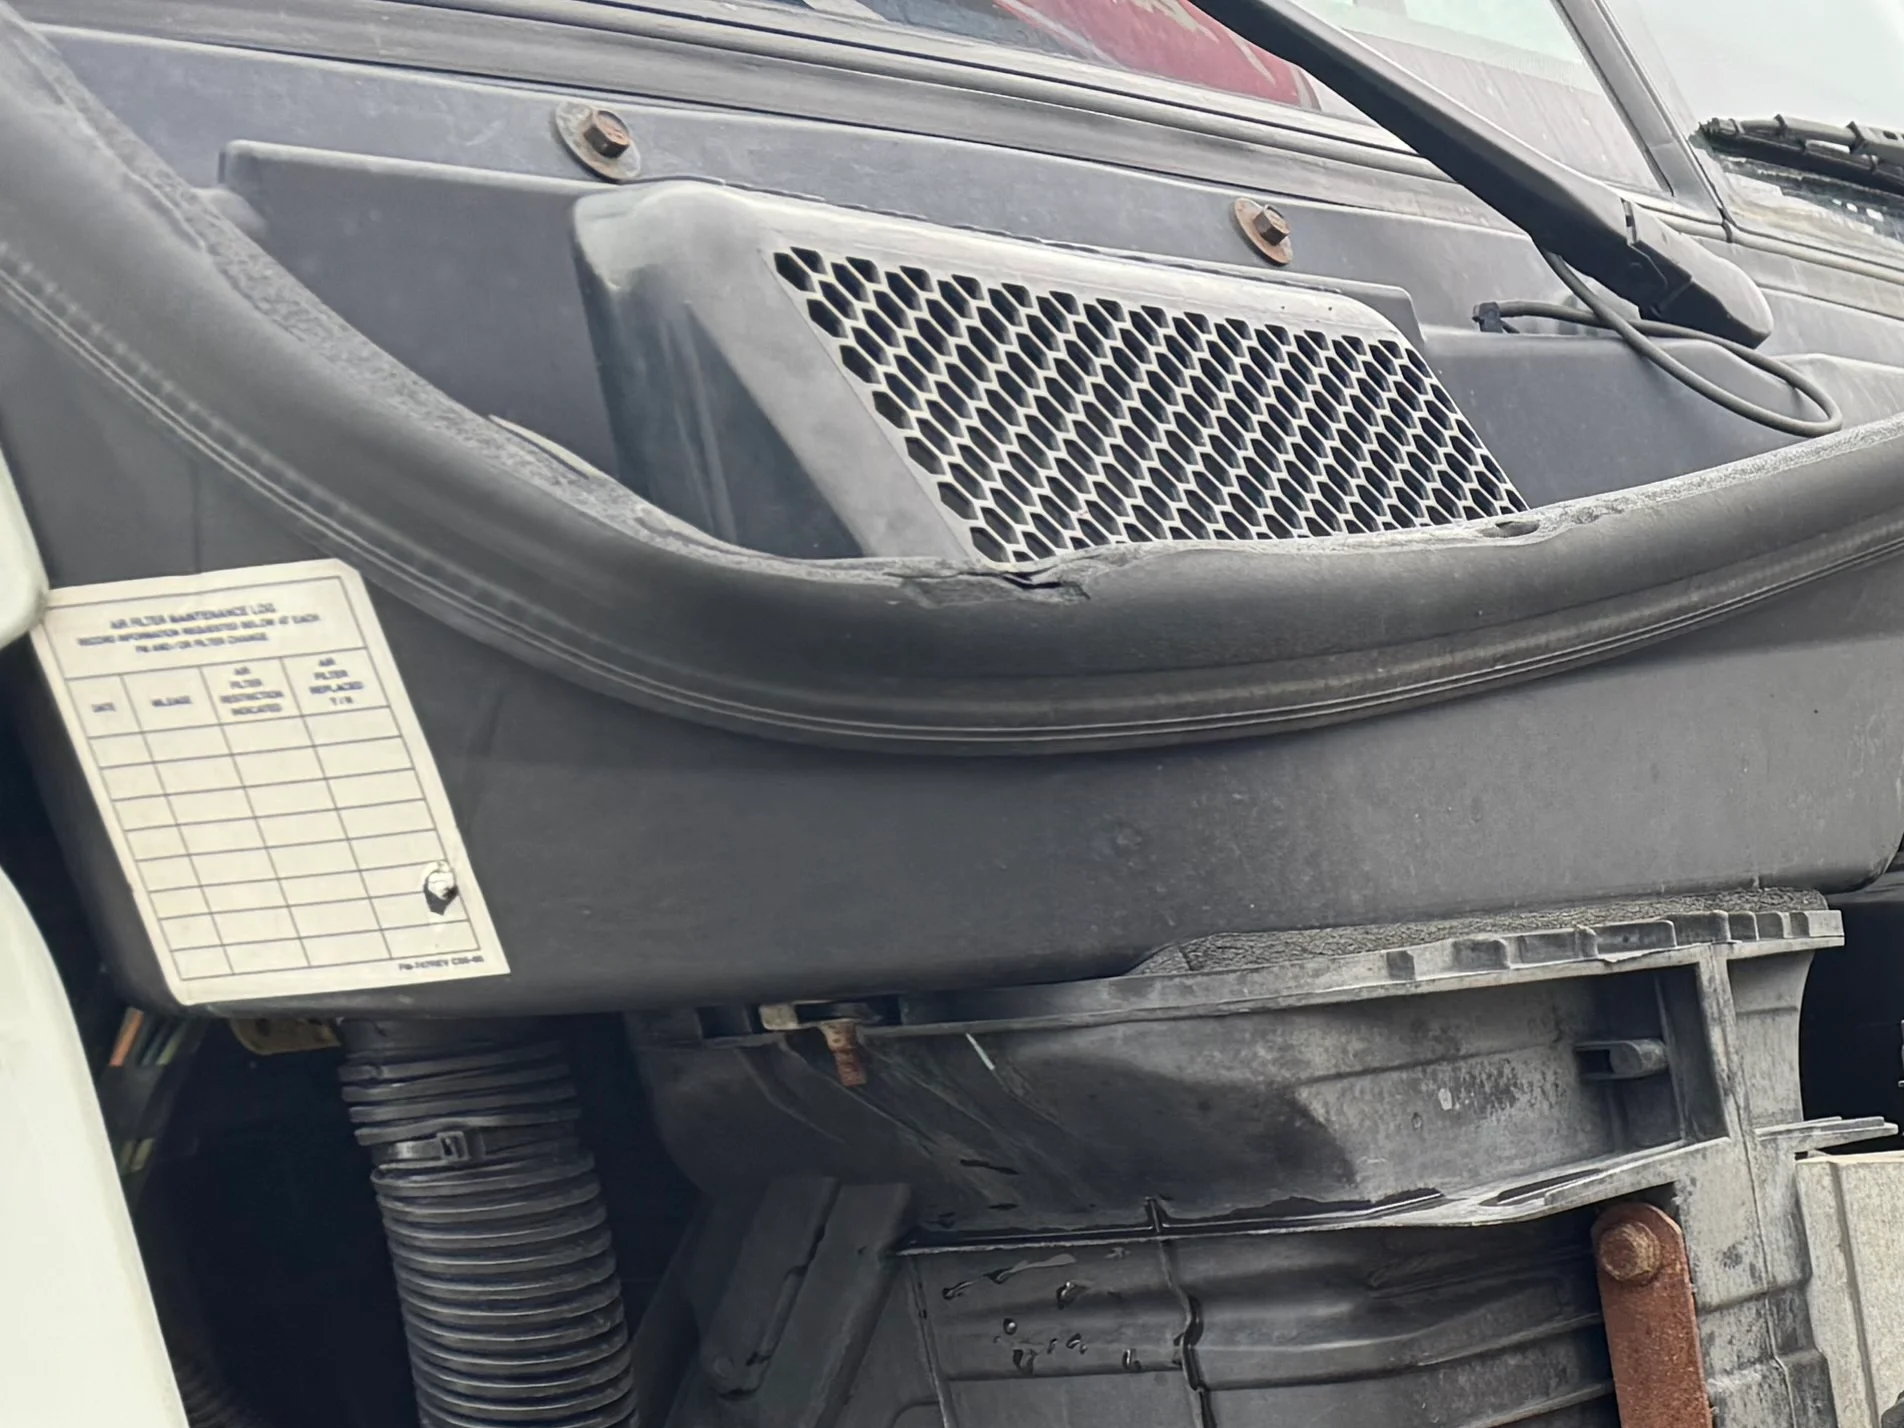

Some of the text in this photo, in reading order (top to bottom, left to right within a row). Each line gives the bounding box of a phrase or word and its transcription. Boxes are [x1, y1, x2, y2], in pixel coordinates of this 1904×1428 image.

[110, 603, 277, 629] AIR FILTER MAINTENANCE LOG
